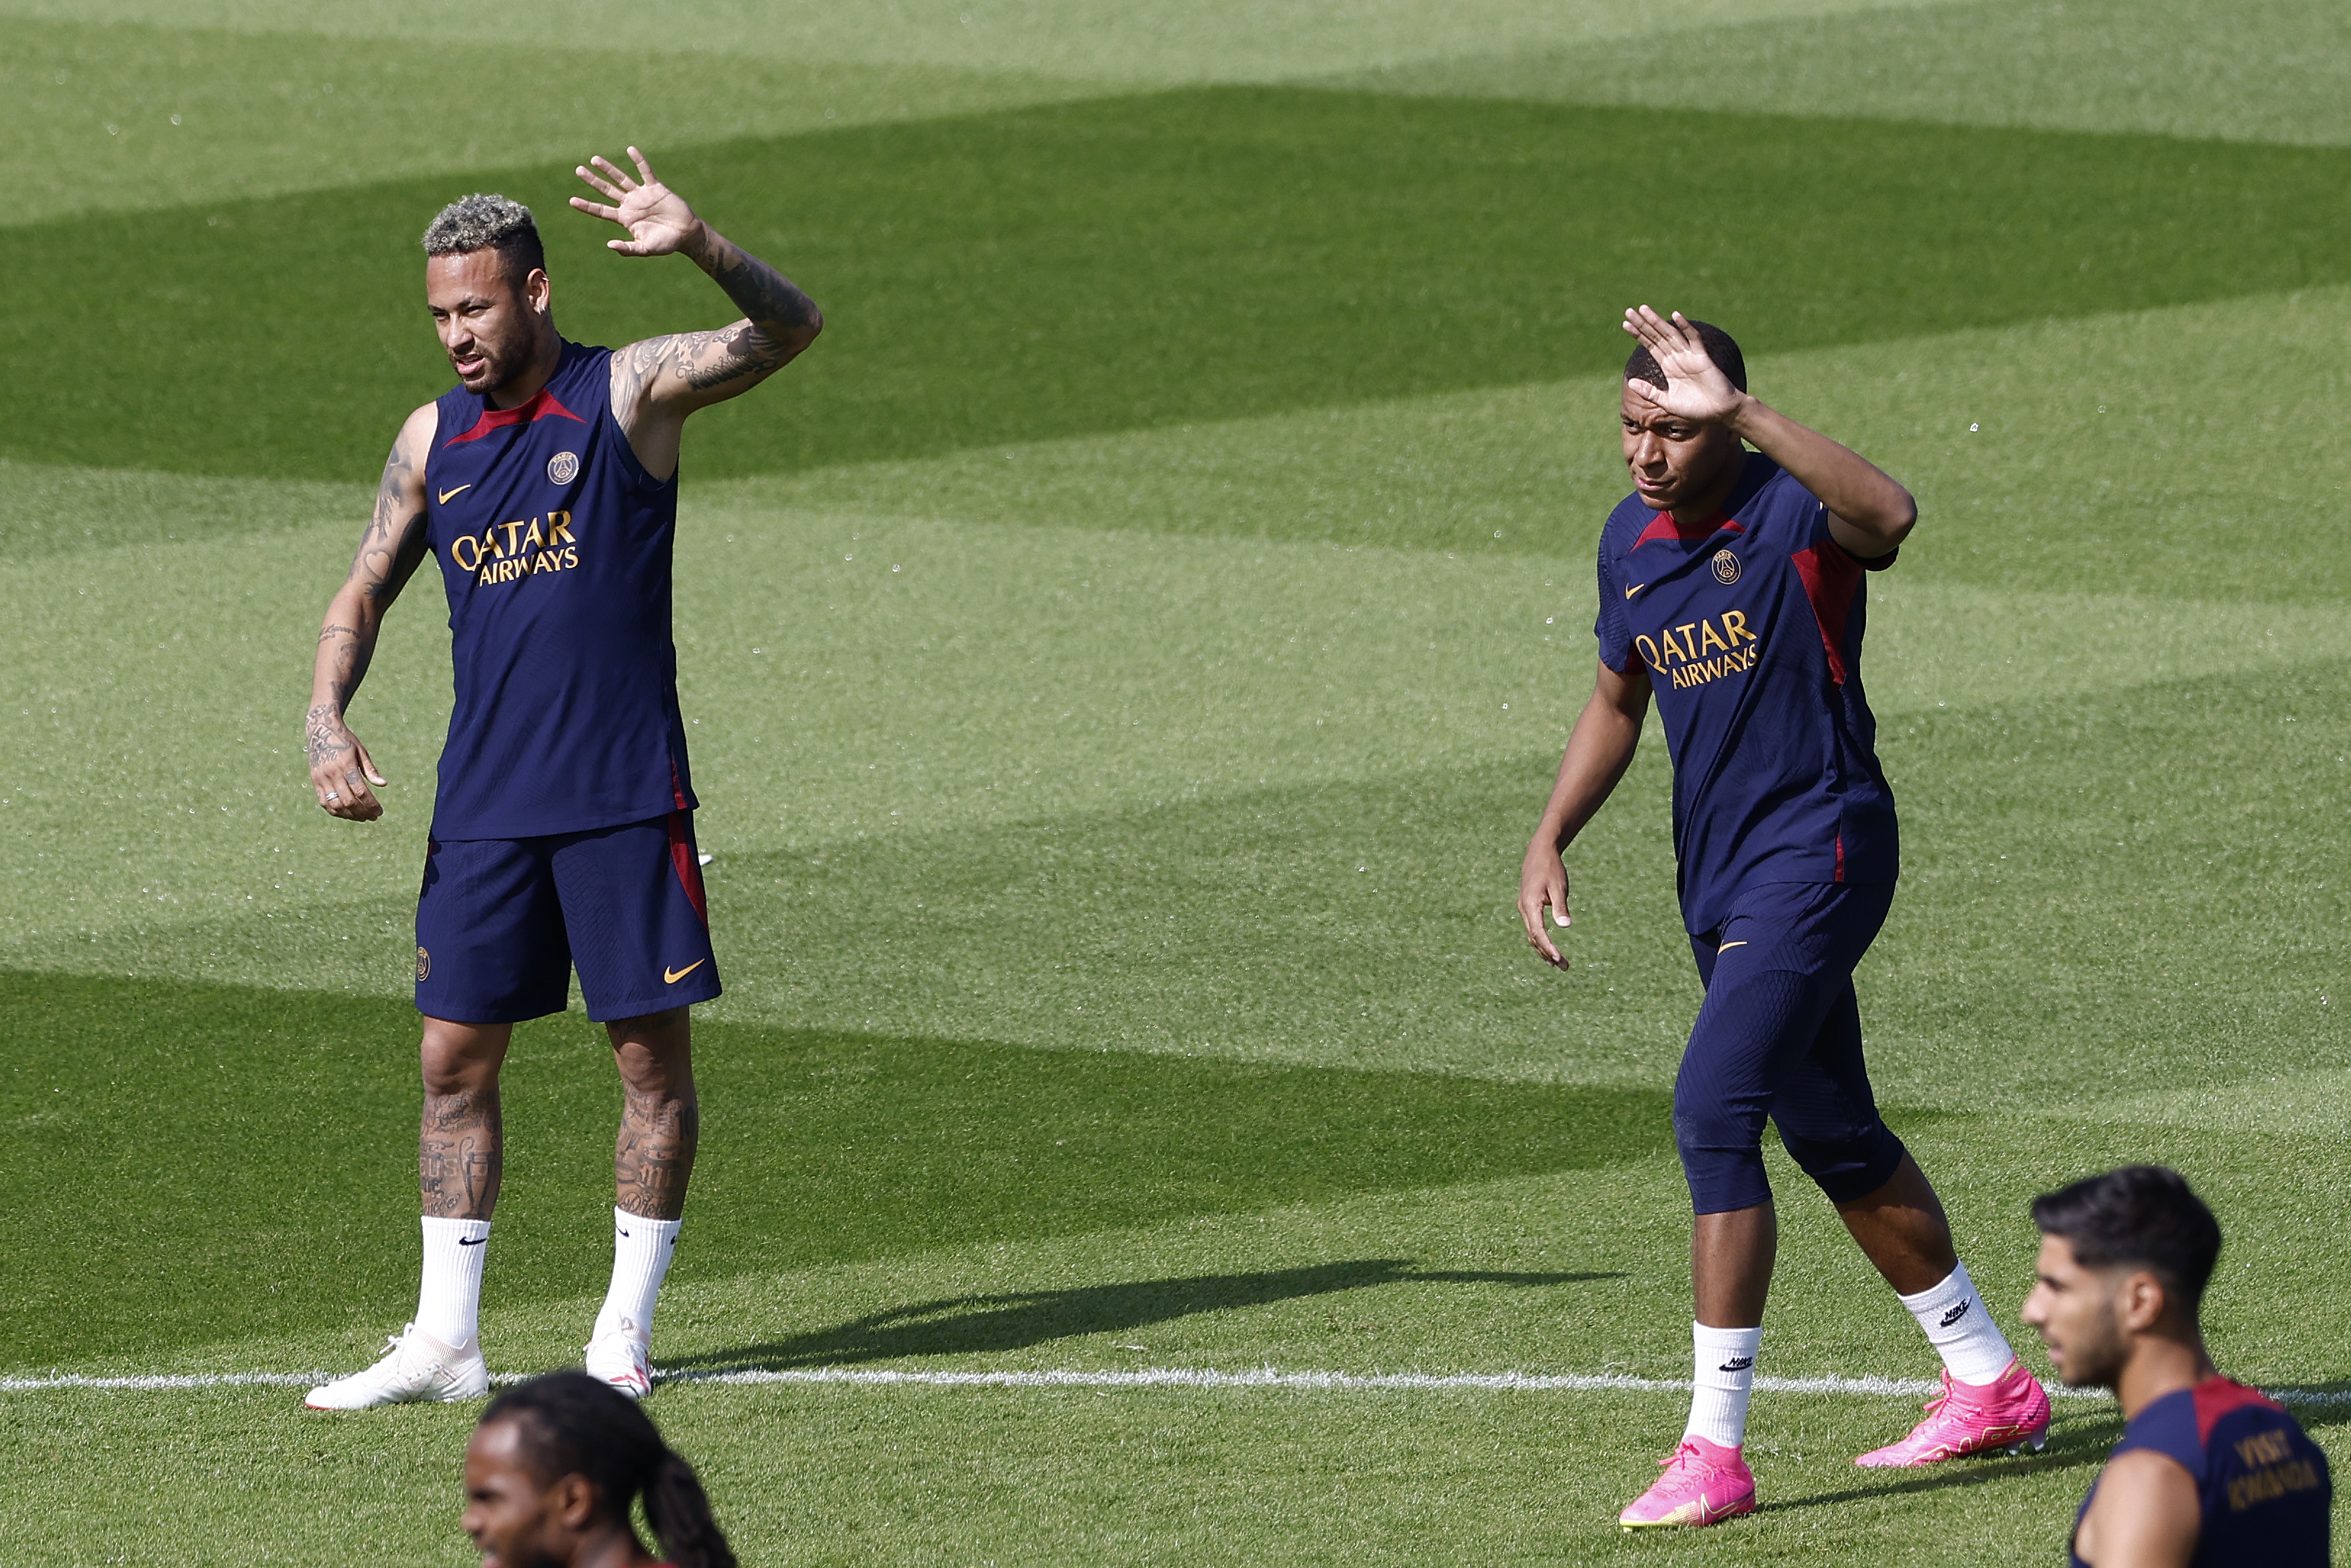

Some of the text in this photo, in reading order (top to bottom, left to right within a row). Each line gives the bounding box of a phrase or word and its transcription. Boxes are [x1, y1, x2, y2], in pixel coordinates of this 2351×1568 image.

[451, 509, 577, 572] QATAR
[1714, 551, 1732, 562] PARIS
[479, 546, 580, 587] AIRWAYS
[1635, 609, 1758, 675] QATAR
[1671, 643, 1759, 690] AIRWAYS
[1944, 1298, 1967, 1321] NIKE
[1727, 1357, 1753, 1367] NIKE
